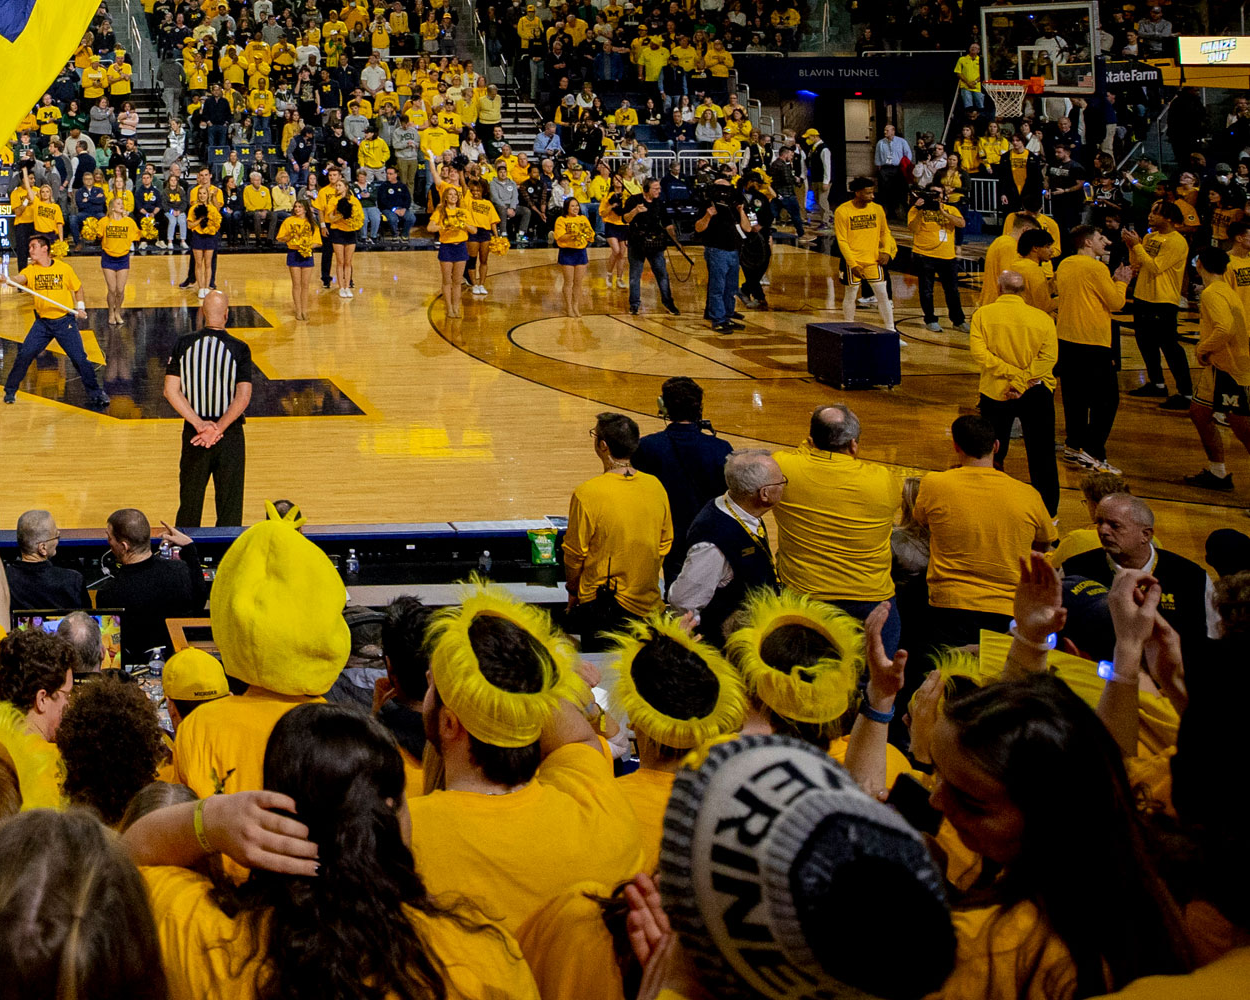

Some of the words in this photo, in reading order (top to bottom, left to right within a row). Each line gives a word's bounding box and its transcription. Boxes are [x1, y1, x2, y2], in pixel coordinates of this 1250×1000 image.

[799, 69, 834, 77] BLAVIN
[838, 69, 879, 77] TUNNEL
[444, 117, 454, 125] M
[1222, 393, 1239, 407] M
